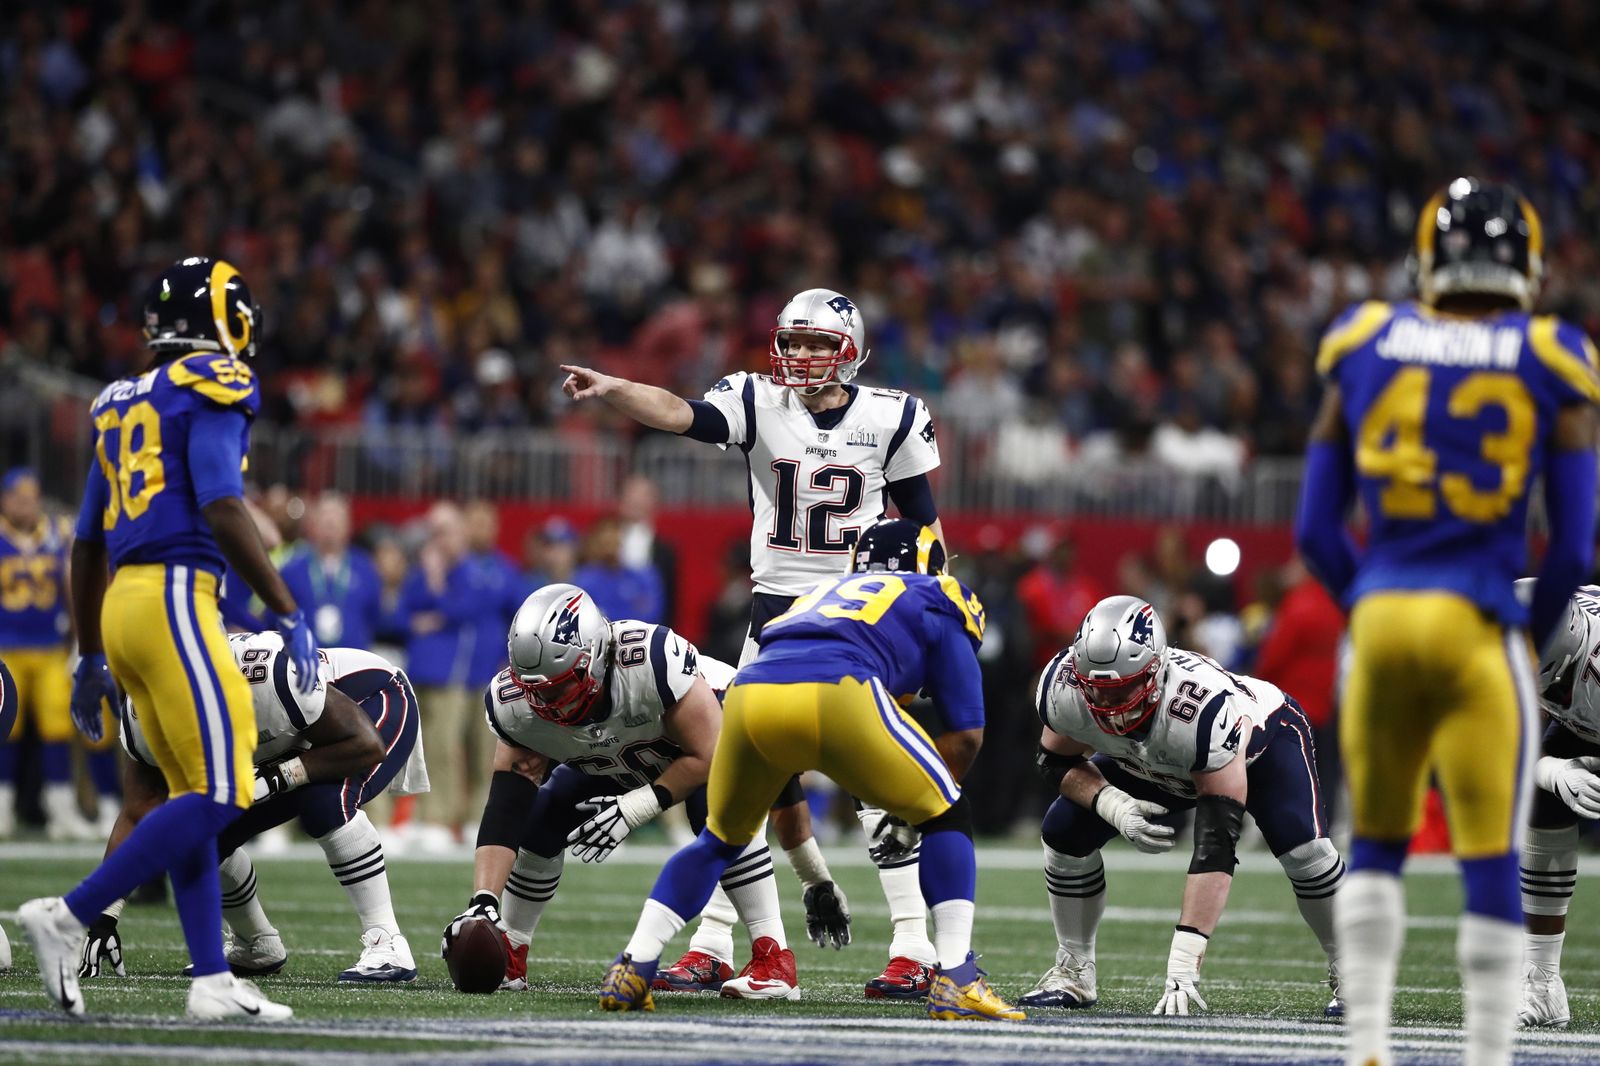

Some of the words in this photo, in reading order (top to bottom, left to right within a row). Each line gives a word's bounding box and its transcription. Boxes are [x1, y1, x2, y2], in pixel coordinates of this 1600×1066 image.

[209, 358, 253, 386] 58
[95, 400, 166, 531] 58
[805, 446, 838, 458] PATRIOTS
[1356, 365, 1537, 523] 43
[767, 458, 866, 554] 12
[241, 648, 272, 684] 69
[619, 627, 650, 669] 60
[1167, 680, 1212, 725] 62
